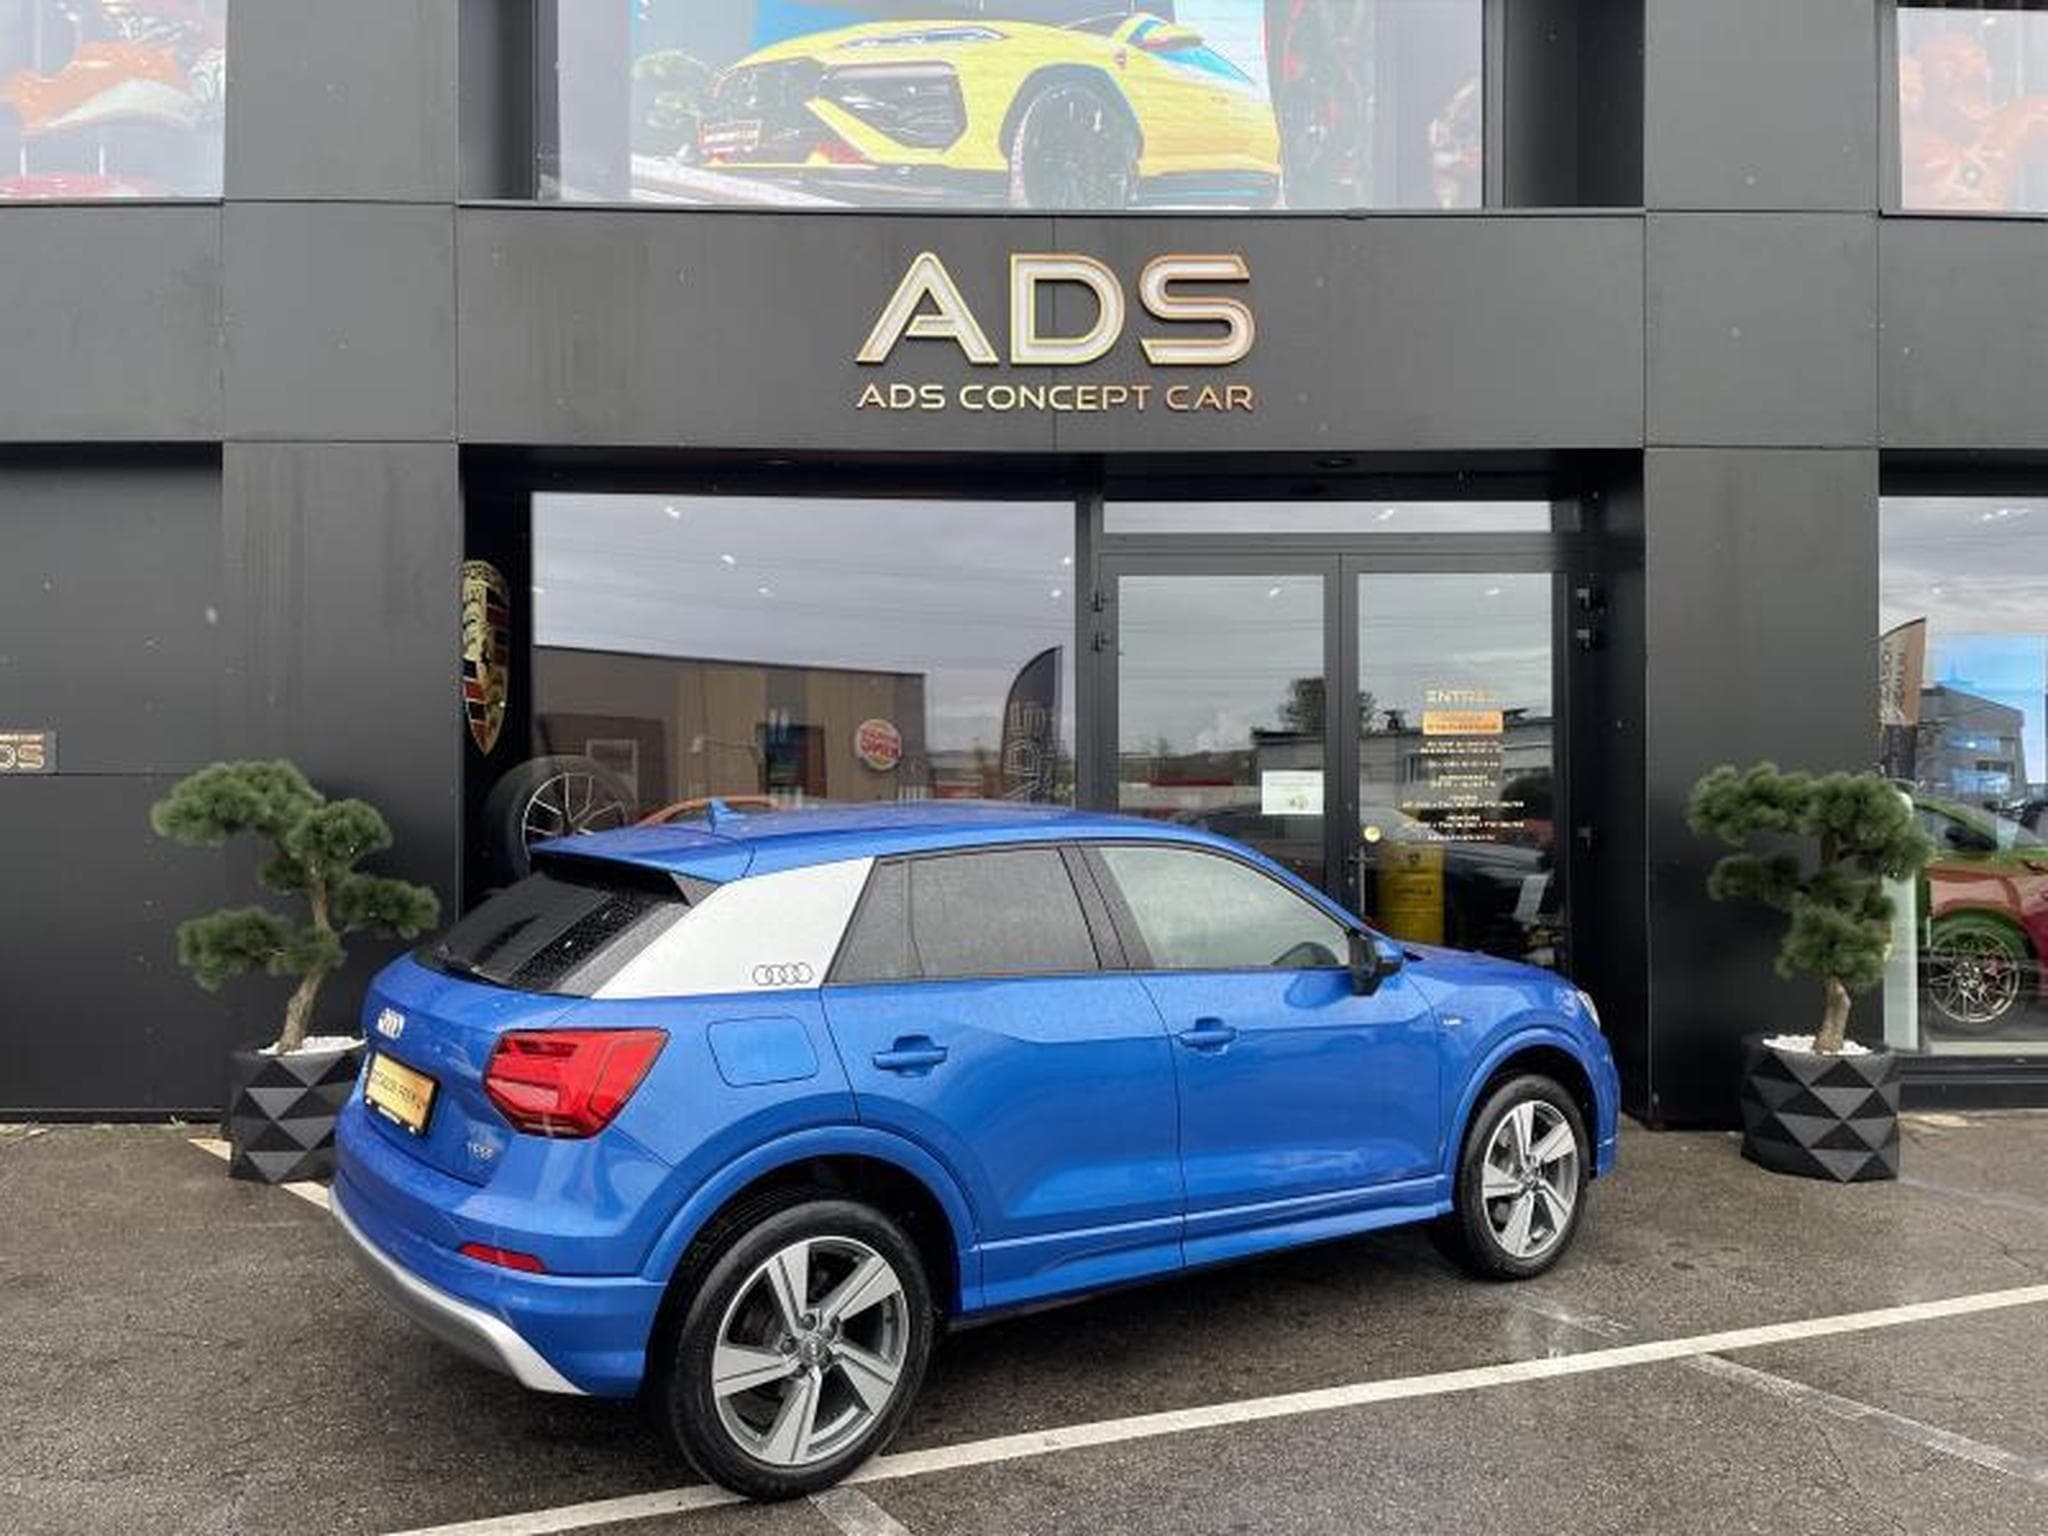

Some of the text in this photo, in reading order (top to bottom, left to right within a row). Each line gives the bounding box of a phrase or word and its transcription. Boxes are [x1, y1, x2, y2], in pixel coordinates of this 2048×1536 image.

[855, 250, 1256, 366] ADS
[856, 383, 1255, 412] ADS CONCEPT CAR
